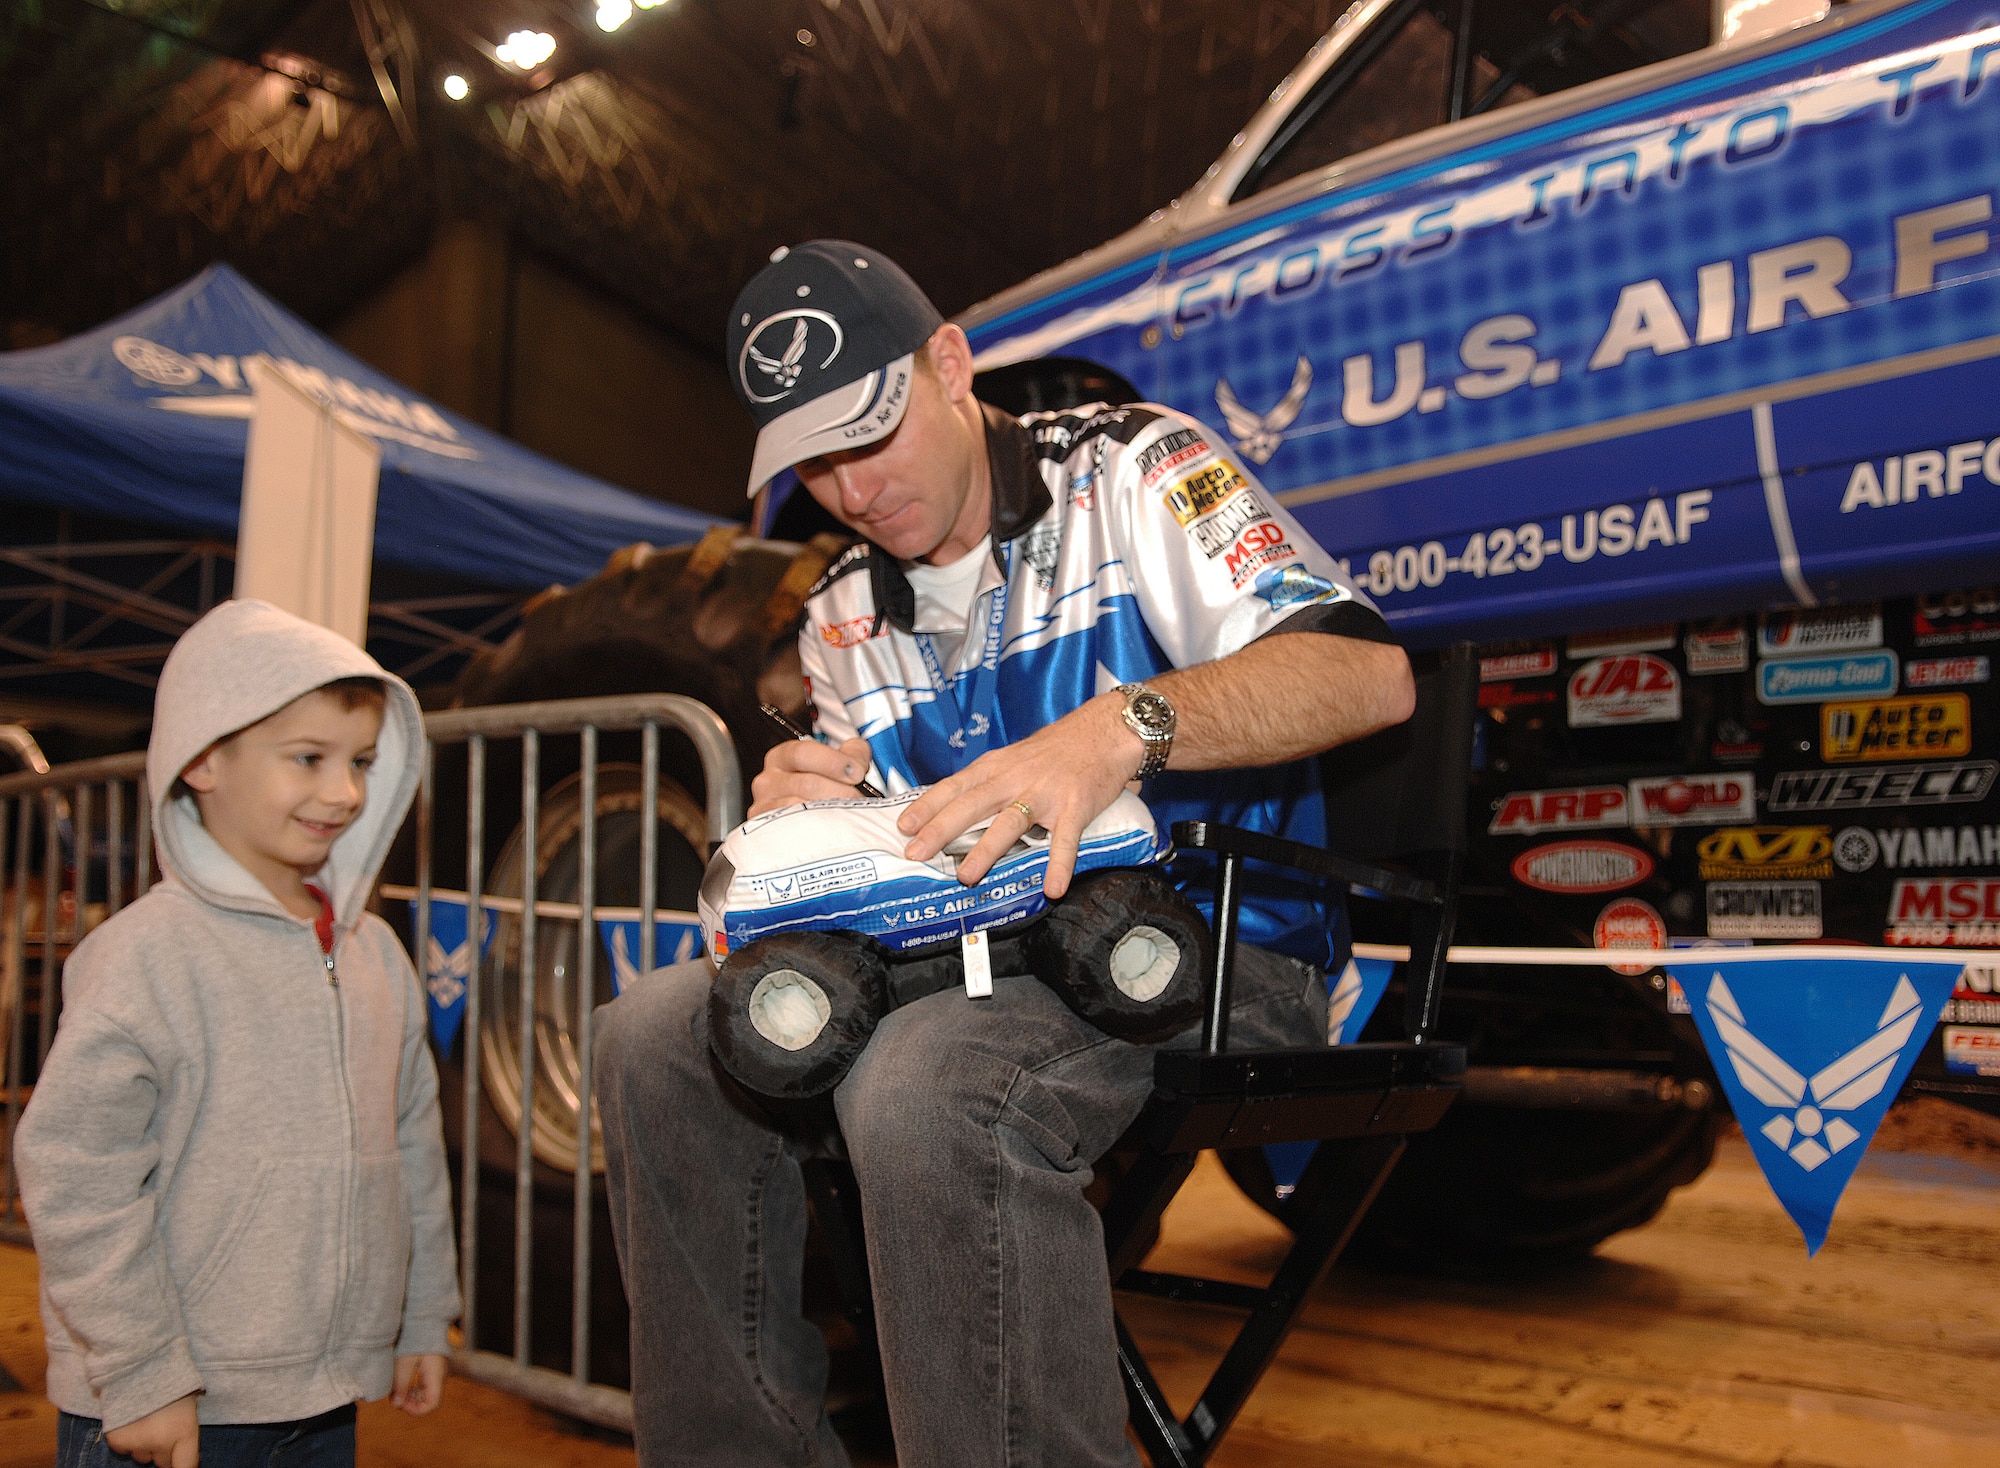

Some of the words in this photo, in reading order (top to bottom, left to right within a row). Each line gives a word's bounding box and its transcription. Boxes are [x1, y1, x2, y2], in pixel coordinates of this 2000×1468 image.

[1341, 314, 1561, 427] U.S.
[1588, 235, 1852, 371] AIR
[877, 409, 892, 425] Air
[1187, 467, 1225, 497] Auto
[1192, 473, 1241, 513] Meter
[1225, 522, 1285, 575] MSD
[1340, 488, 1713, 597] -800-423-USAF
[1869, 705, 1945, 727] Auto
[1860, 727, 1963, 752] Meter
[1774, 766, 1988, 810] WISECO
[1498, 791, 1624, 827] ARP
[819, 868, 835, 878] AIR
[836, 861, 867, 874] FORCE
[904, 905, 941, 923] U.S.
[943, 895, 976, 915] AIR
[979, 872, 1043, 905] FORCE
